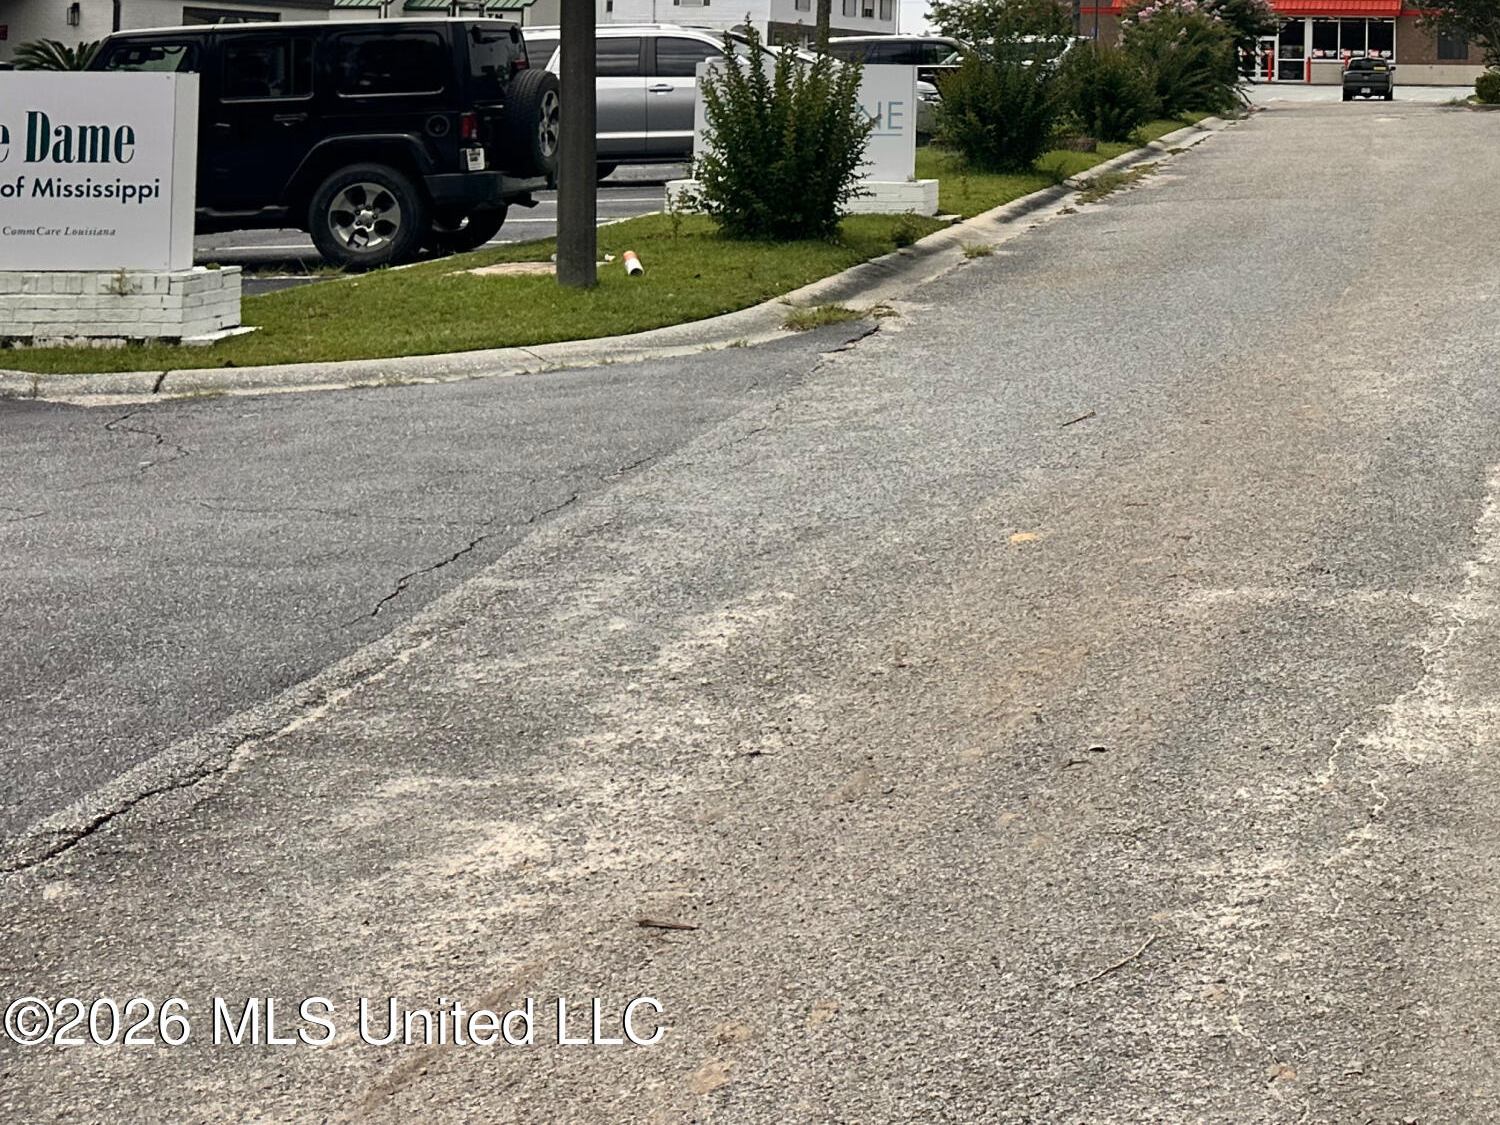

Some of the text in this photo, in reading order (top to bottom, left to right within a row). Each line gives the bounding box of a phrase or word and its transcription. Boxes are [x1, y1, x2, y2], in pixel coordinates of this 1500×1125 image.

[23, 110, 136, 164] Dame
[0, 175, 160, 204] of Mississippi
[2, 226, 117, 236] CommCare Louisiana
